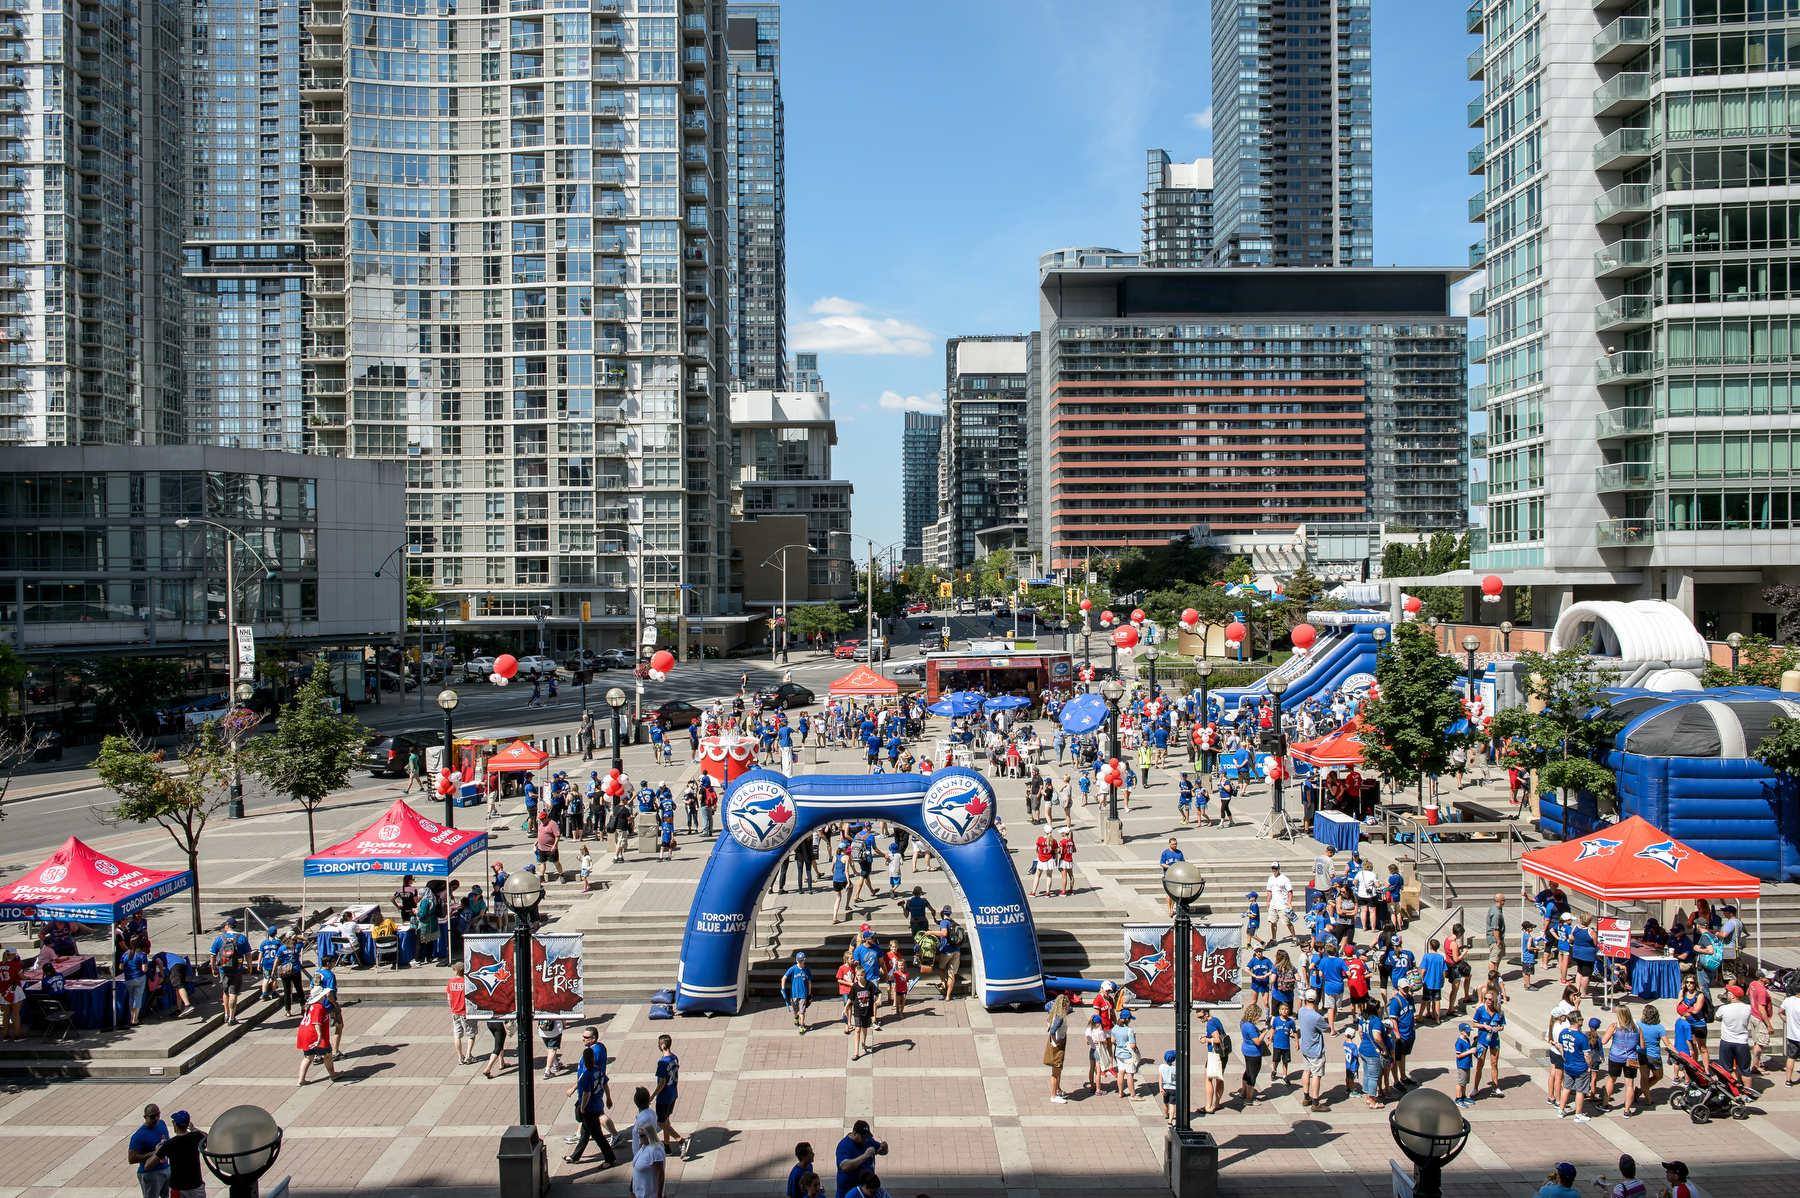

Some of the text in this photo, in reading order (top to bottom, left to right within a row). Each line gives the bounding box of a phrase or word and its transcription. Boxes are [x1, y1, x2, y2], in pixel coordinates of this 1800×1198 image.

[733, 784, 779, 806] TORONTO
[928, 779, 972, 804] TORONTO
[431, 829, 454, 844] Boston
[732, 823, 757, 846] BLUE
[929, 820, 958, 842] BLUE
[357, 841, 412, 849] Boston
[317, 862, 434, 873] TORONTO BLUE JAYS
[103, 870, 143, 888] Boston
[119, 877, 152, 890] Pizza
[12, 885, 77, 894] Boston
[121, 878, 187, 914] TORONTO BLUE JAYS
[37, 908, 65, 918] BLUE
[68, 909, 97, 919] JAYS
[979, 904, 1020, 914] TORONTO
[701, 912, 744, 921] TORONTO
[976, 912, 1025, 925] BLUE JAYS
[697, 920, 746, 932] BLUE JAYS
[1395, 957, 1408, 968] 20
[1563, 1040, 1575, 1053] 55
